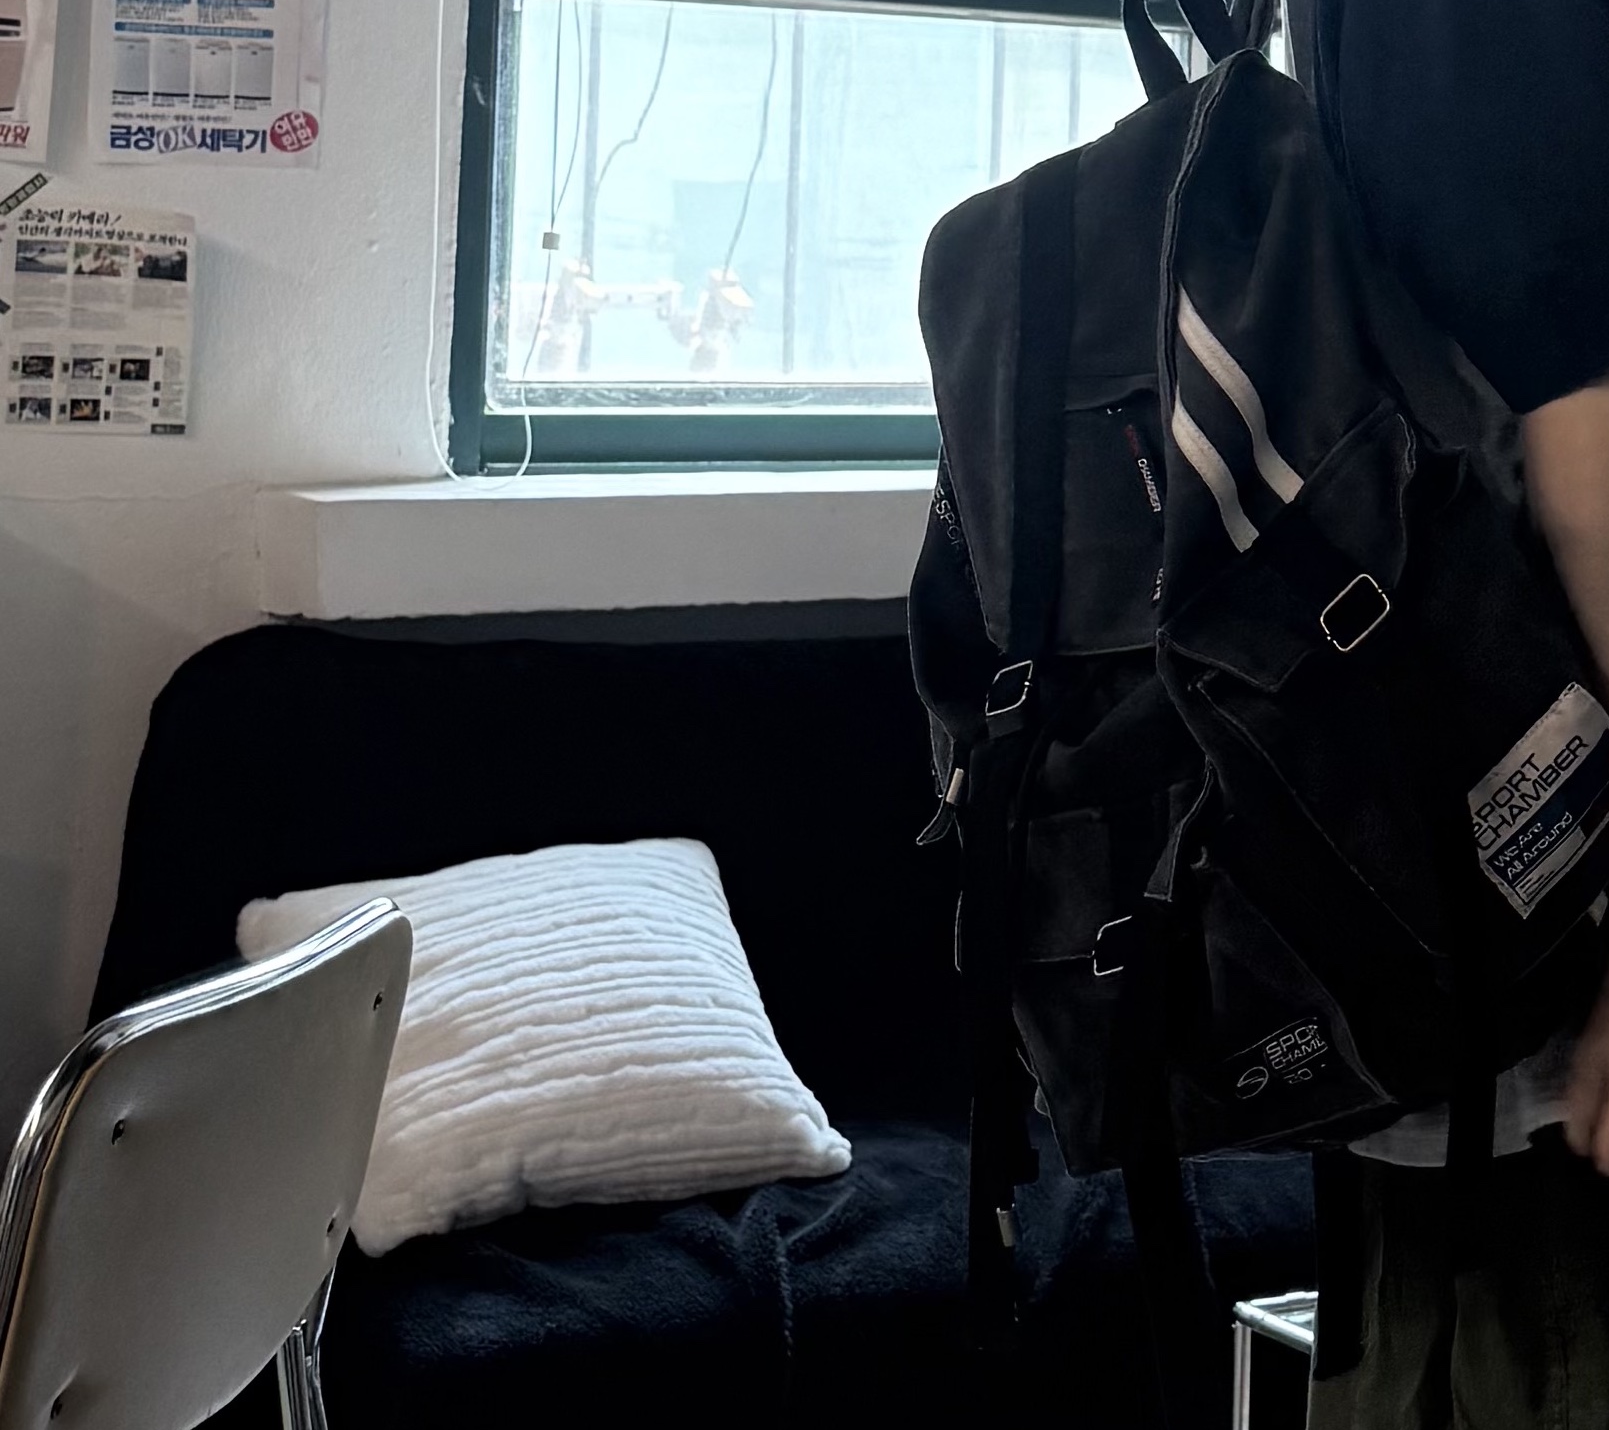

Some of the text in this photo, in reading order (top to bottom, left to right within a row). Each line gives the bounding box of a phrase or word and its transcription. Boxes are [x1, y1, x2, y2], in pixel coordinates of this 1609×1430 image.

[110, 125, 155, 151] 금성
[198, 128, 267, 153] 세탁기
[1478, 735, 1589, 851] CHAMBER
[1523, 811, 1573, 865] Around
